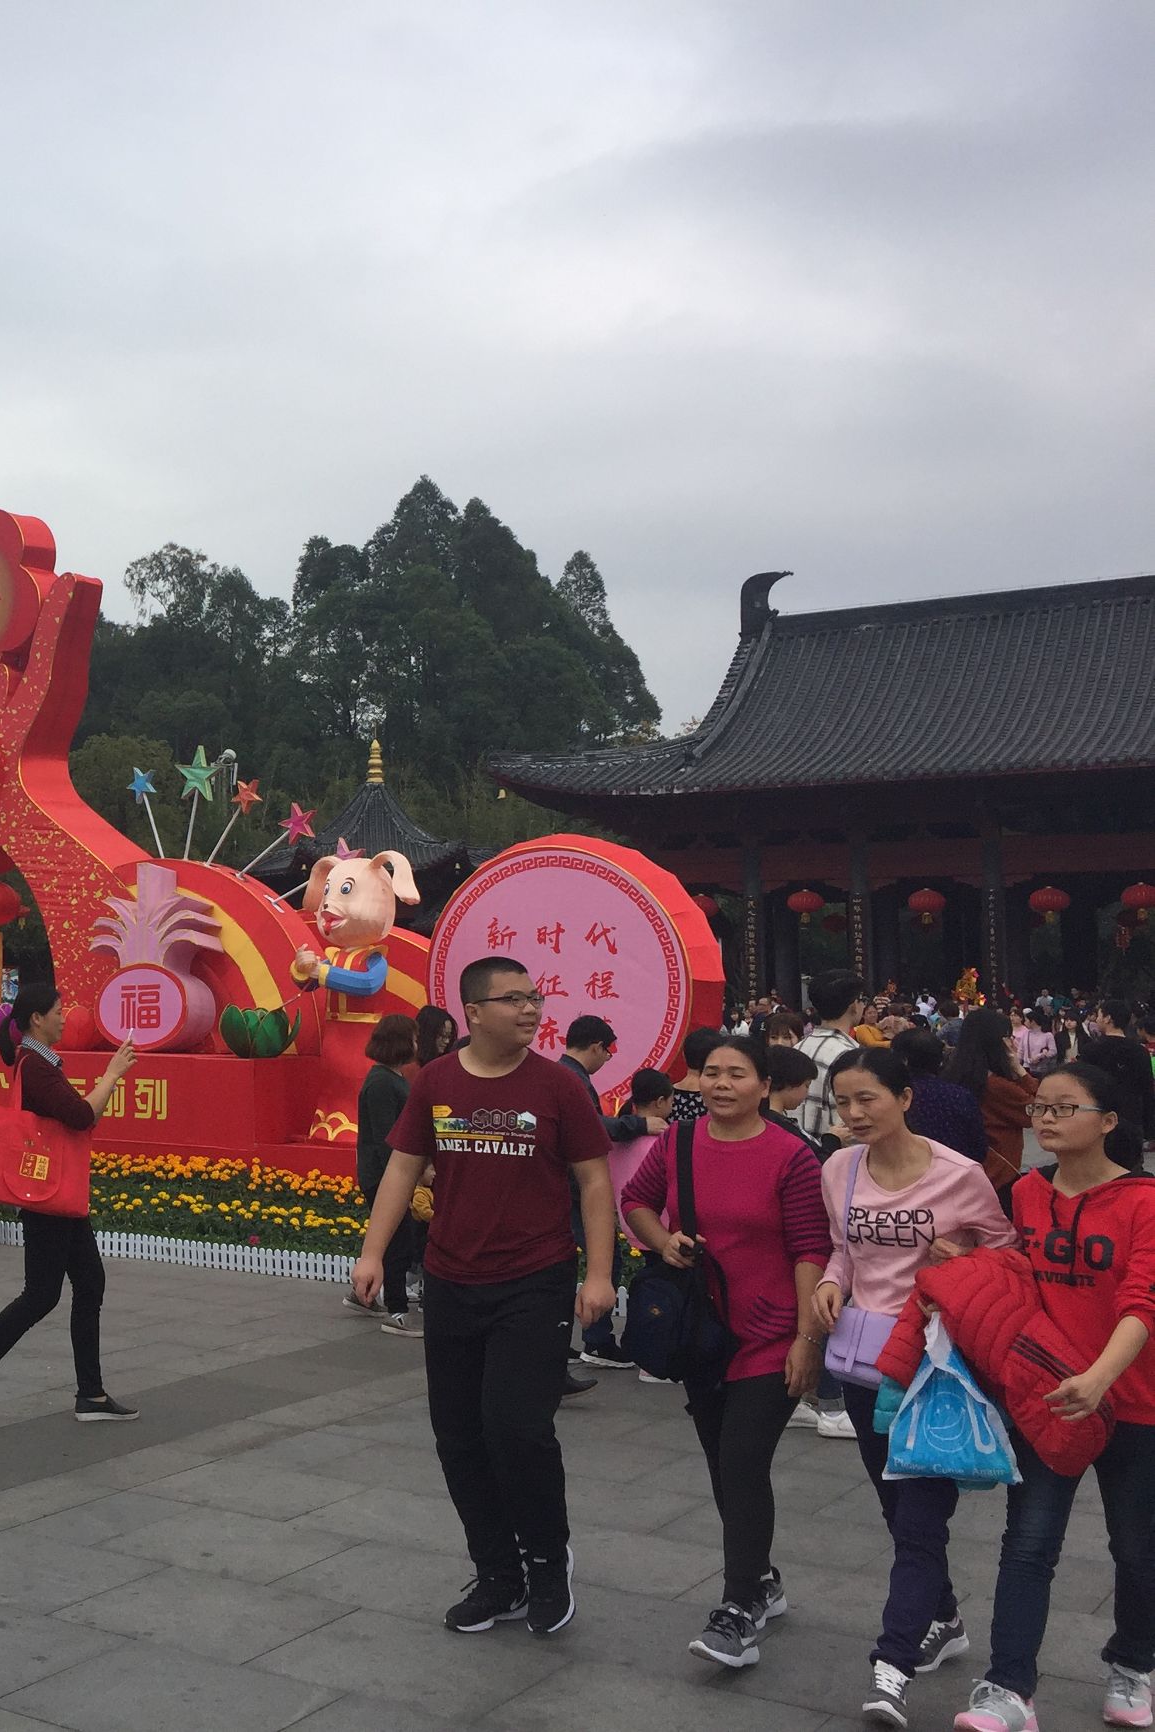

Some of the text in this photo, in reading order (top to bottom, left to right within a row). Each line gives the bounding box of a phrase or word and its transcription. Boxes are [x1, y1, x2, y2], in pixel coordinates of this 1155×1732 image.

[487, 917, 618, 955] 新时代
[121, 984, 161, 1030] 福
[474, 1141, 536, 1157] CAVALRY
